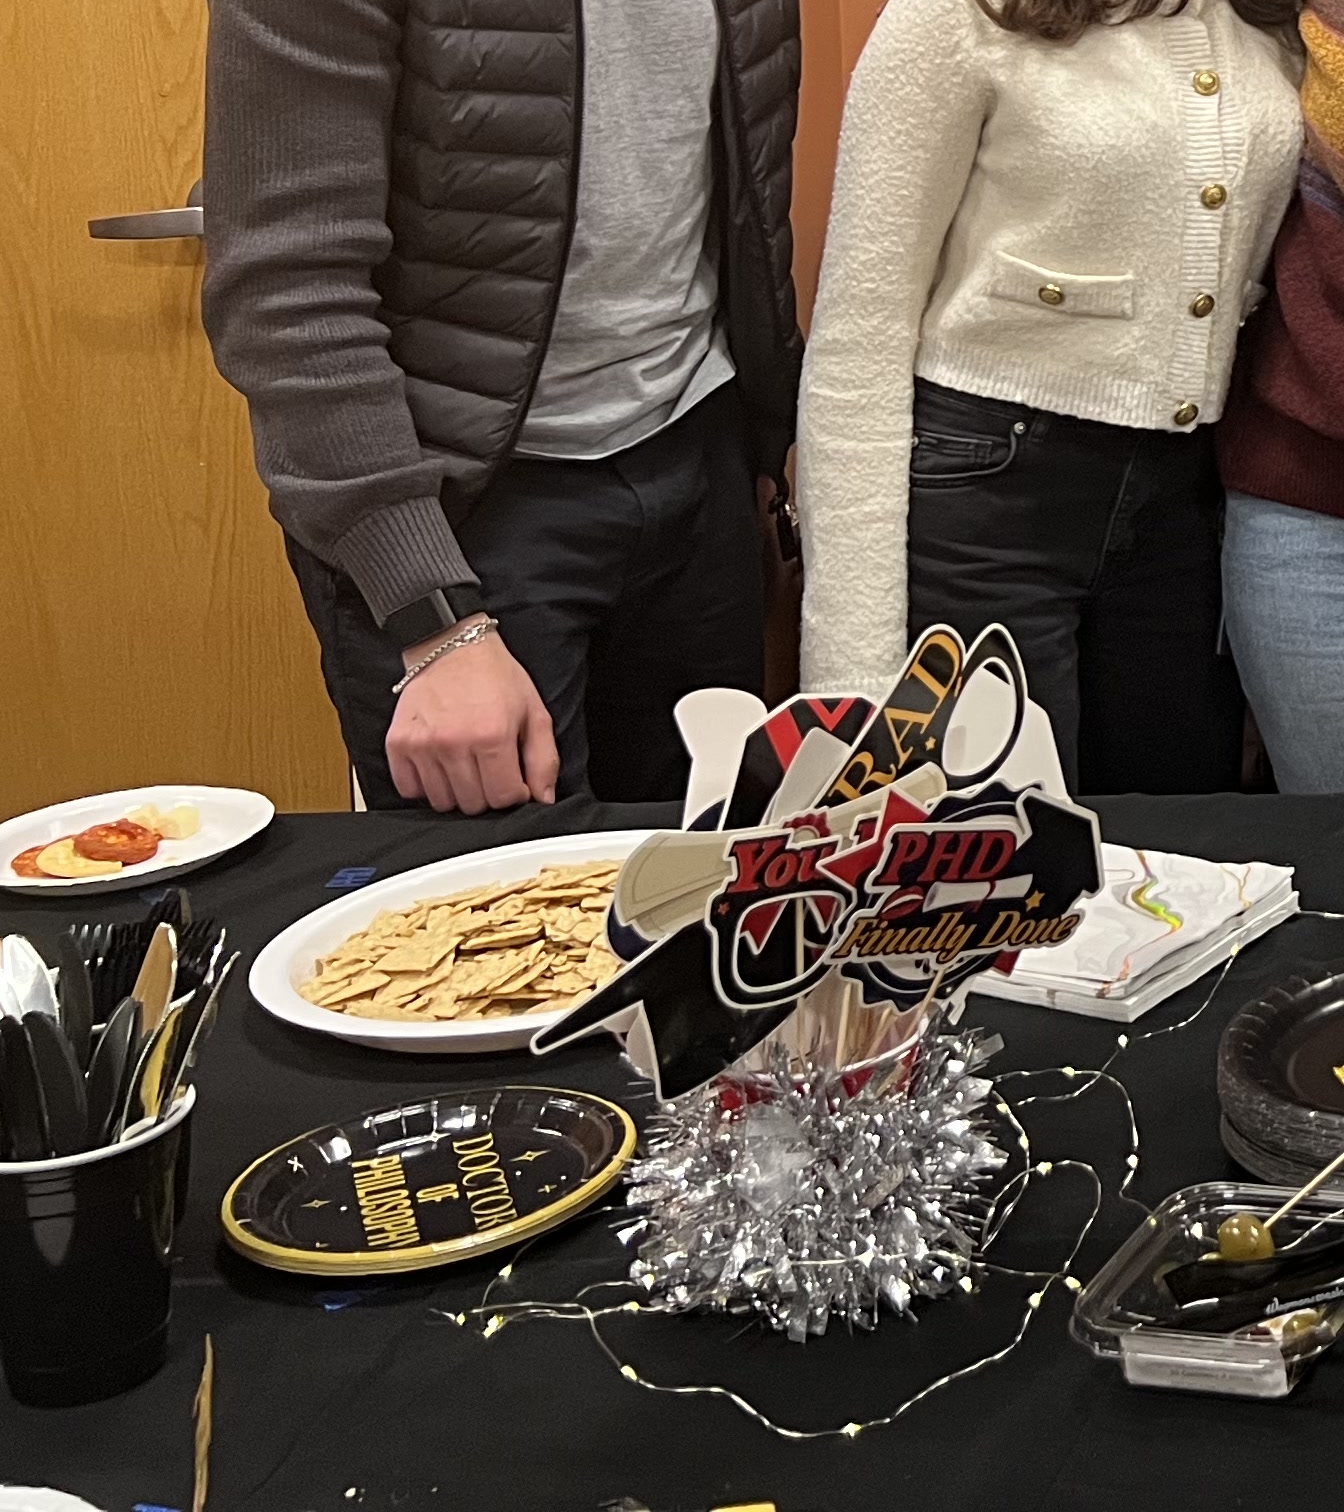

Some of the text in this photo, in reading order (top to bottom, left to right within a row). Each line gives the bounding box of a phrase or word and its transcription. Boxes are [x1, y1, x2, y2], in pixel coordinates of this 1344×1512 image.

[827, 633, 963, 801] RAD
[879, 831, 1016, 884] PHD
[834, 909, 1078, 963] Finally Done
[415, 1183, 460, 1203] OF
[452, 1132, 518, 1231] DOCTOR
